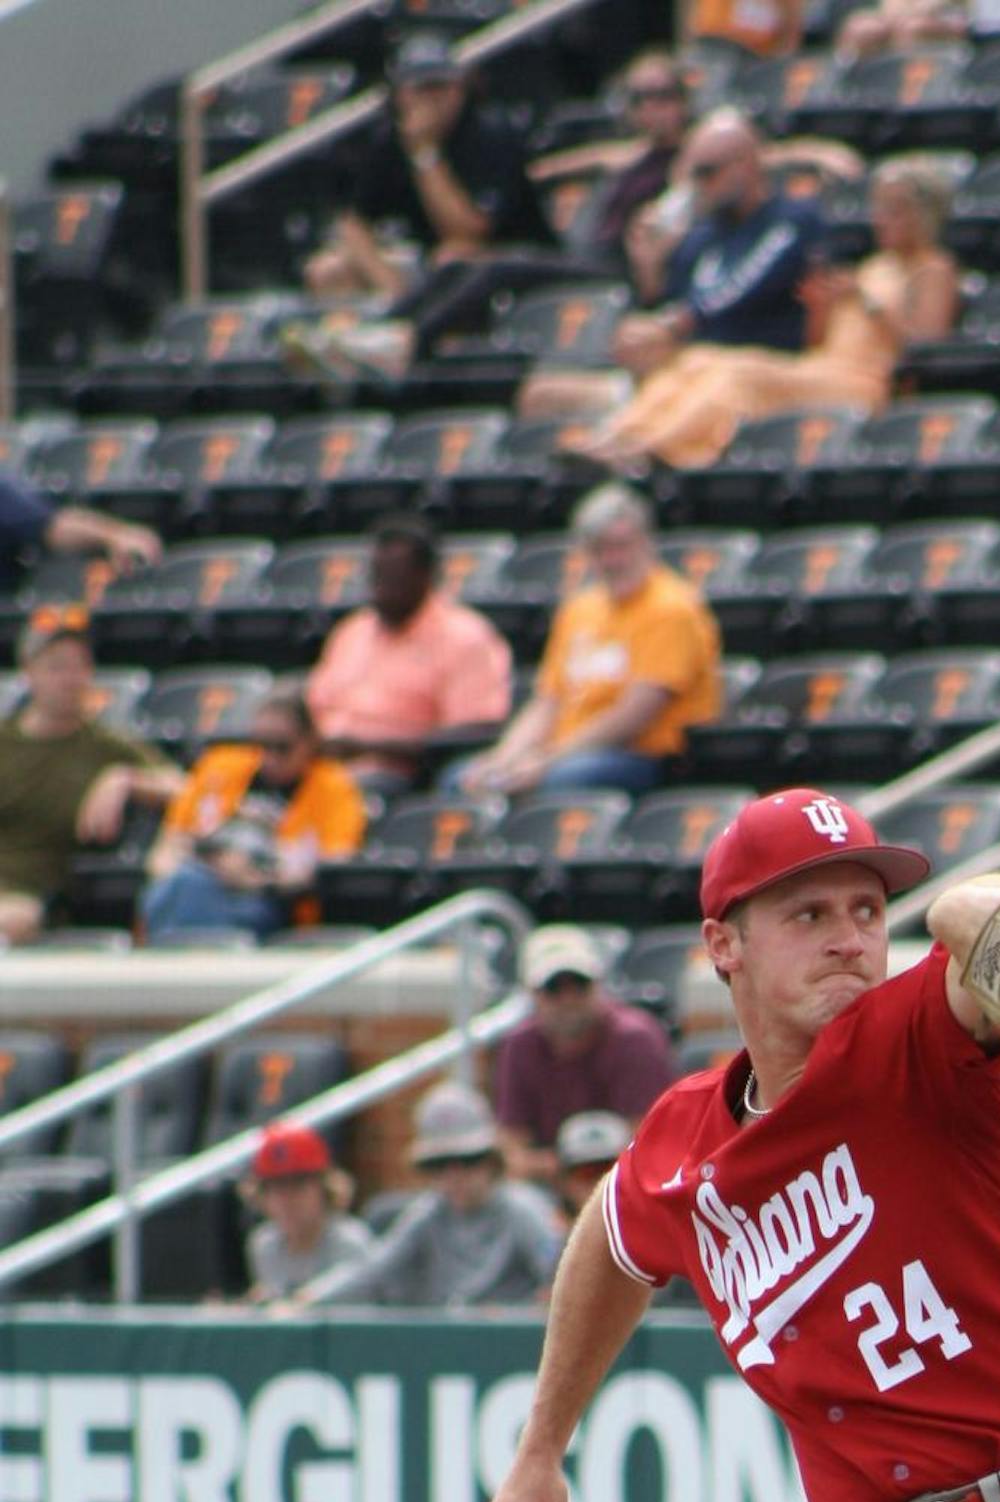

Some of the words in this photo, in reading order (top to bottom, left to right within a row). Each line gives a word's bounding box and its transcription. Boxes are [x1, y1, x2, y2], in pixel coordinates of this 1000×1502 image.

[260, 1052, 293, 1103] T
[691, 1143, 874, 1348] iana
[843, 1259, 972, 1392] 24
